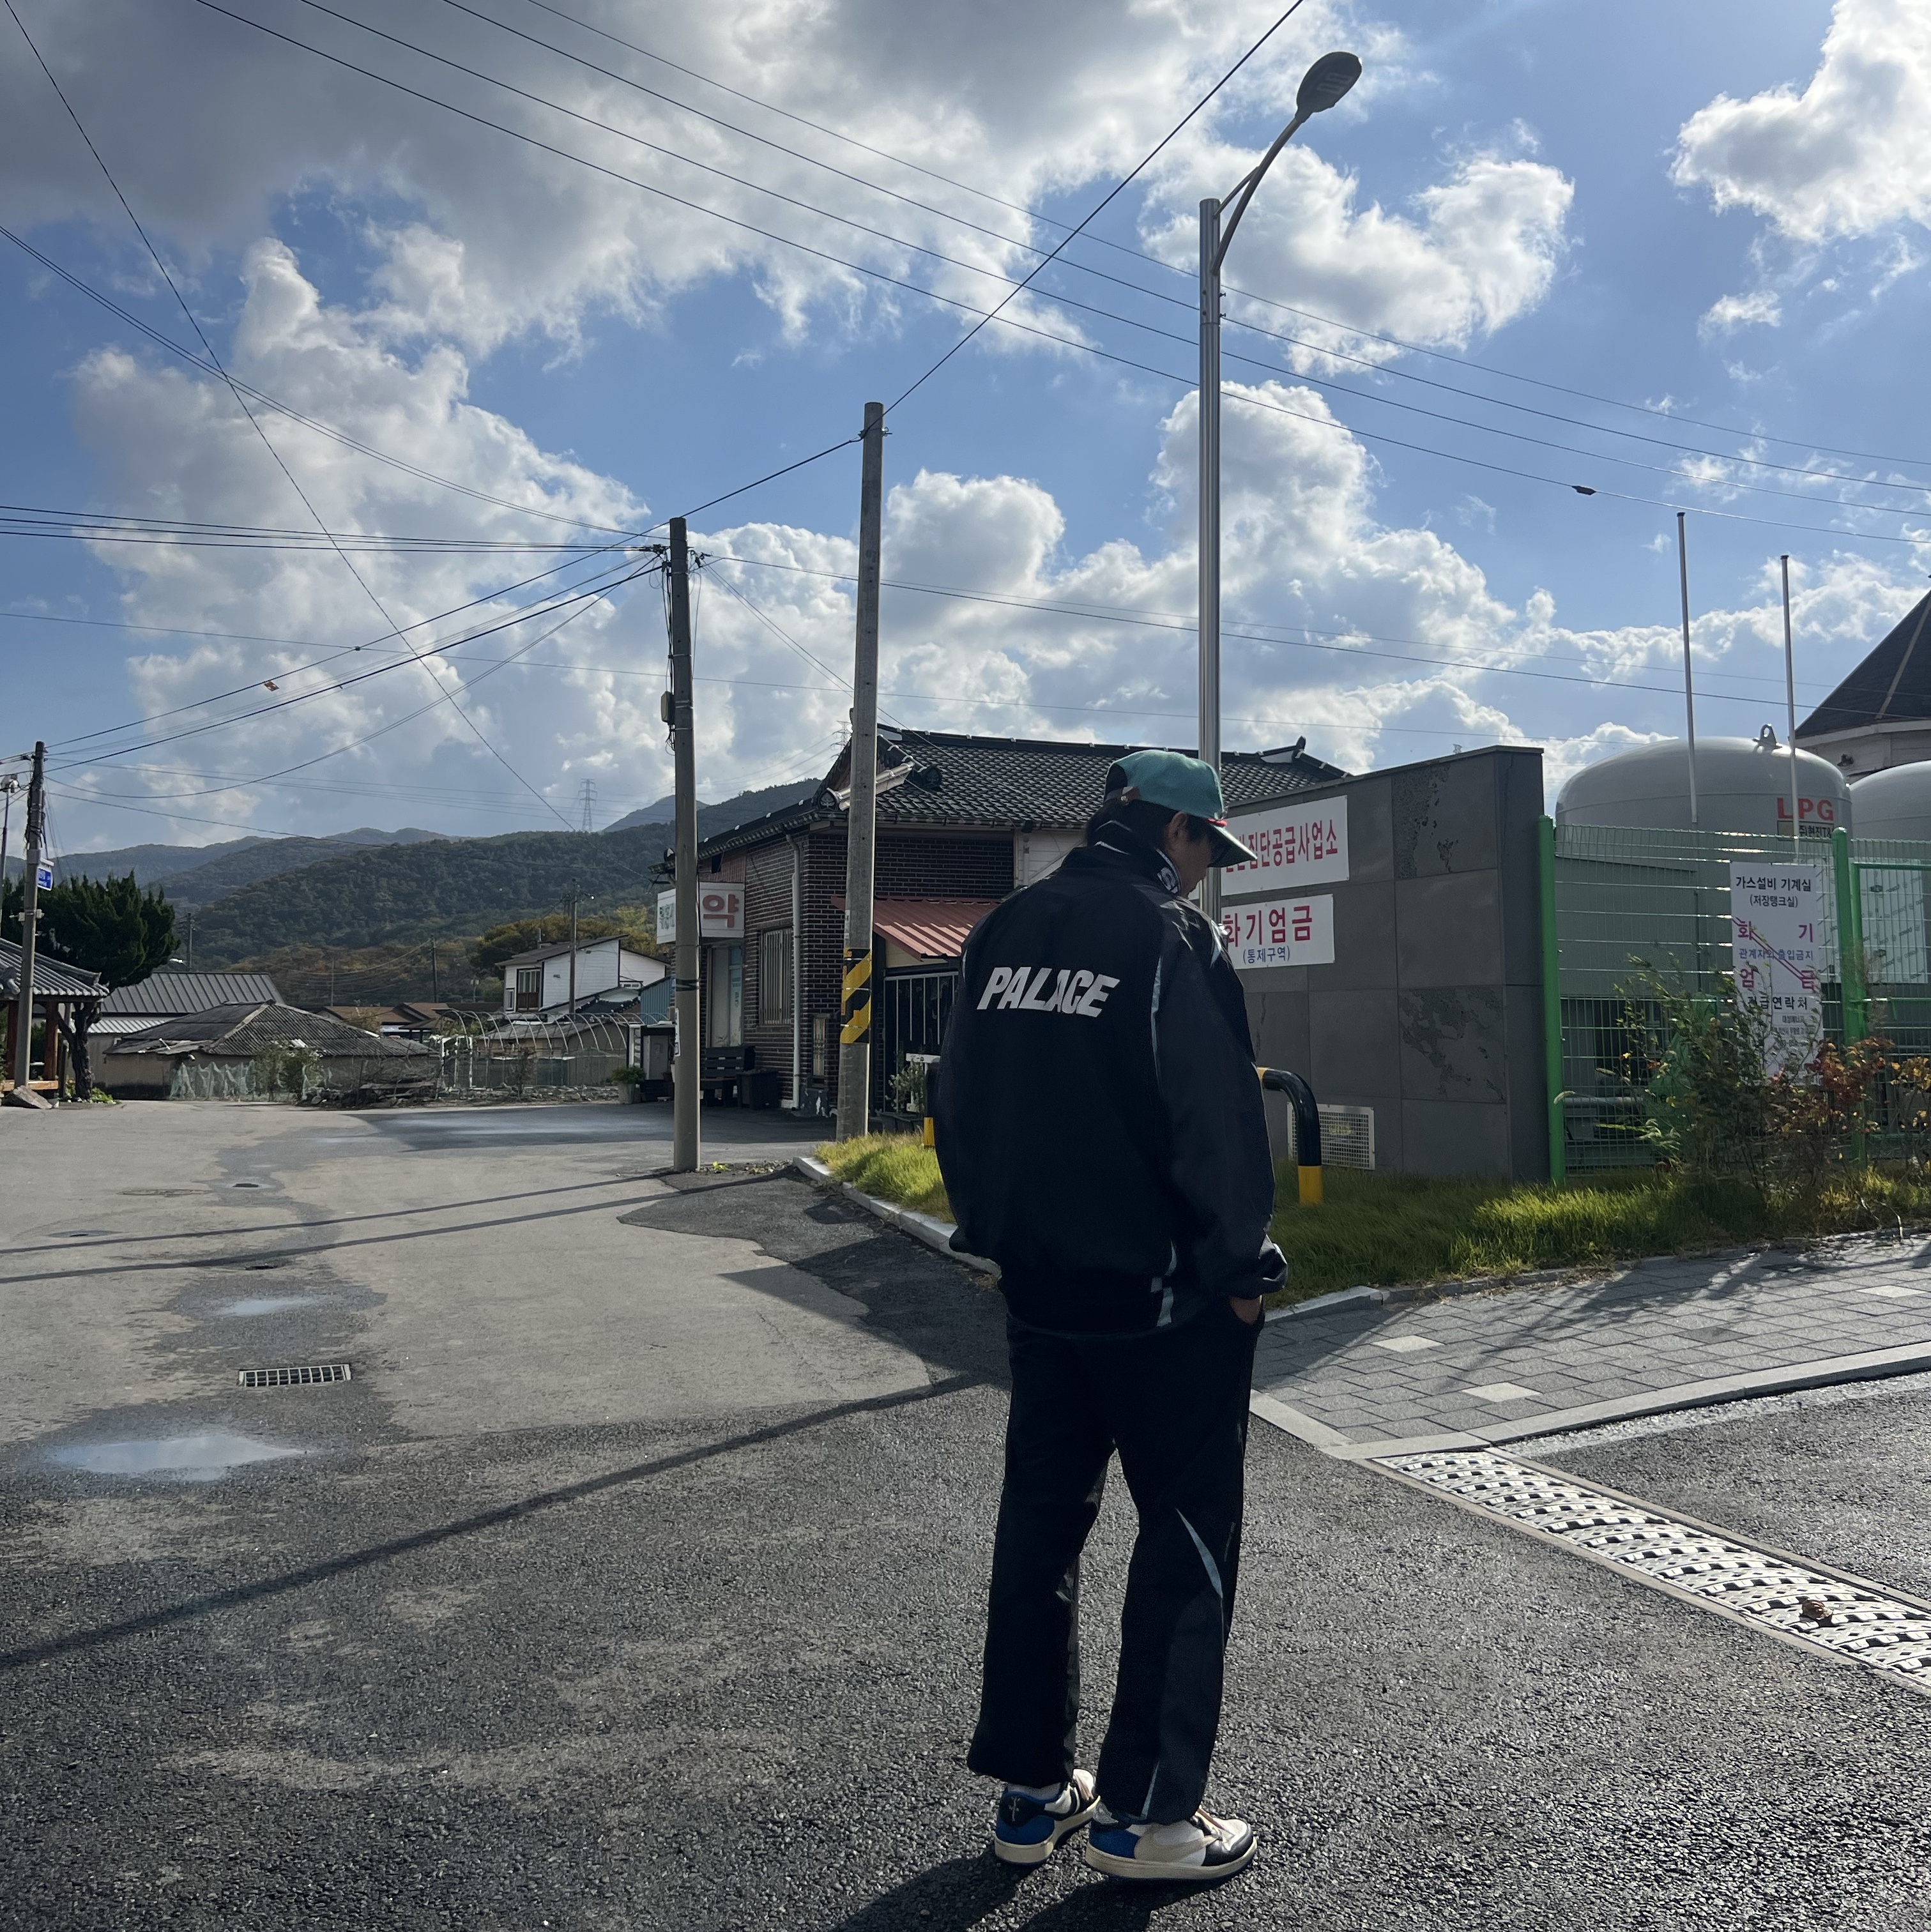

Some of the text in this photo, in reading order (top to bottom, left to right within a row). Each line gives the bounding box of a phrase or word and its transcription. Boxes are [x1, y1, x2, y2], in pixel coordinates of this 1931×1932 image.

[1777, 797, 1834, 821] LPG
[1736, 876, 1811, 892] 가스설비 기계실
[703, 894, 739, 928] 약
[1749, 894, 1798, 908] (저장탱크실)
[1222, 906, 1312, 947] 화기엄금
[1242, 945, 1290, 964] (통제구역)
[976, 966, 1120, 1017] PALACE
